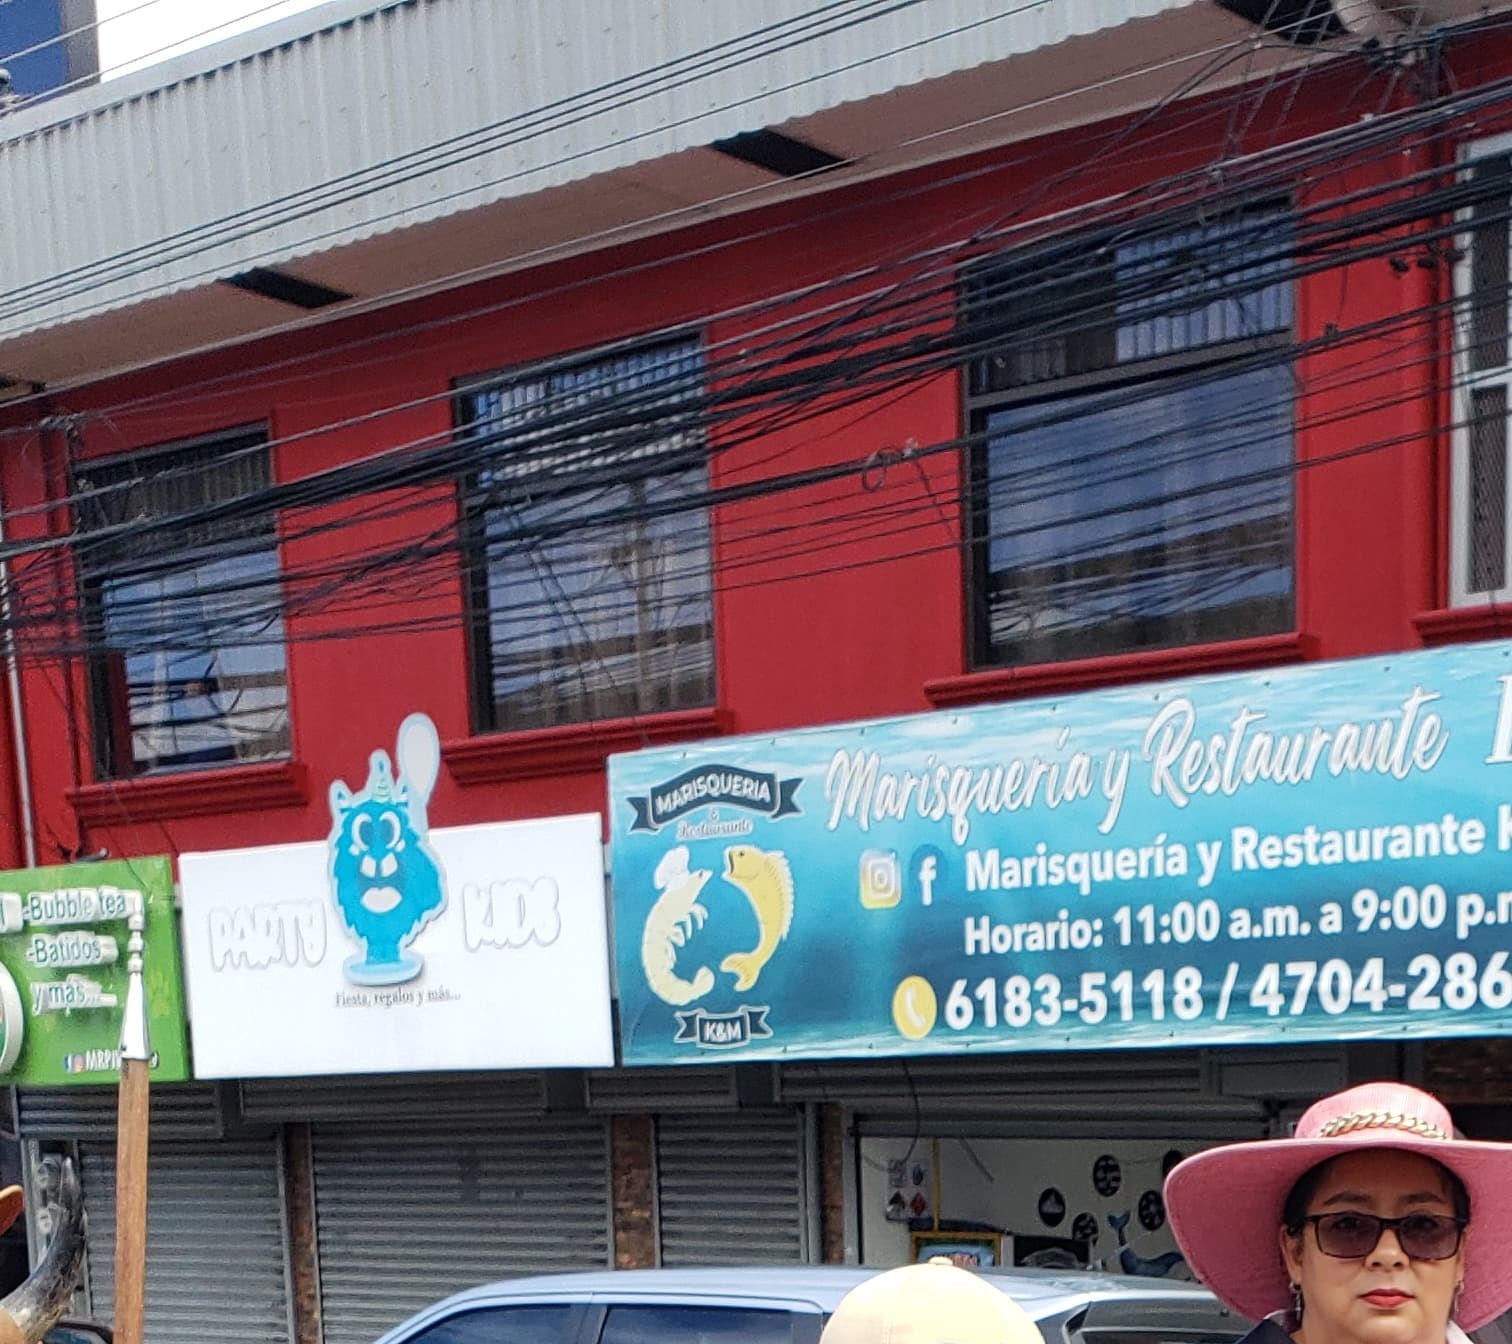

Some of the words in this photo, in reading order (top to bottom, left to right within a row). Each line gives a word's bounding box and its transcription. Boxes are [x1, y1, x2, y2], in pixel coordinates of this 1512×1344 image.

[825, 726, 1093, 845] Marisquería
[1099, 750, 1130, 834] y
[1141, 685, 1450, 808] Restaurante
[656, 772, 771, 815] MARISQUERIA
[965, 832, 1188, 896] Marisquería
[1197, 839, 1222, 887] y
[1231, 813, 1486, 871] Restaurante
[99, 891, 126, 914] tea
[208, 899, 328, 973] PARTY
[462, 876, 562, 954] KIDS
[965, 908, 1103, 955] Horario:
[1113, 899, 1221, 947] 11:00
[1228, 904, 1311, 938] a.m.
[1319, 901, 1343, 934] a
[1352, 884, 1446, 933] 9:00
[33, 983, 44, 1012] y
[374, 986, 414, 1008] regalos
[416, 989, 424, 1007] y
[944, 965, 1203, 1030] 6183-5118
[1216, 962, 1241, 1020] /
[703, 1020, 742, 1041] K&M
